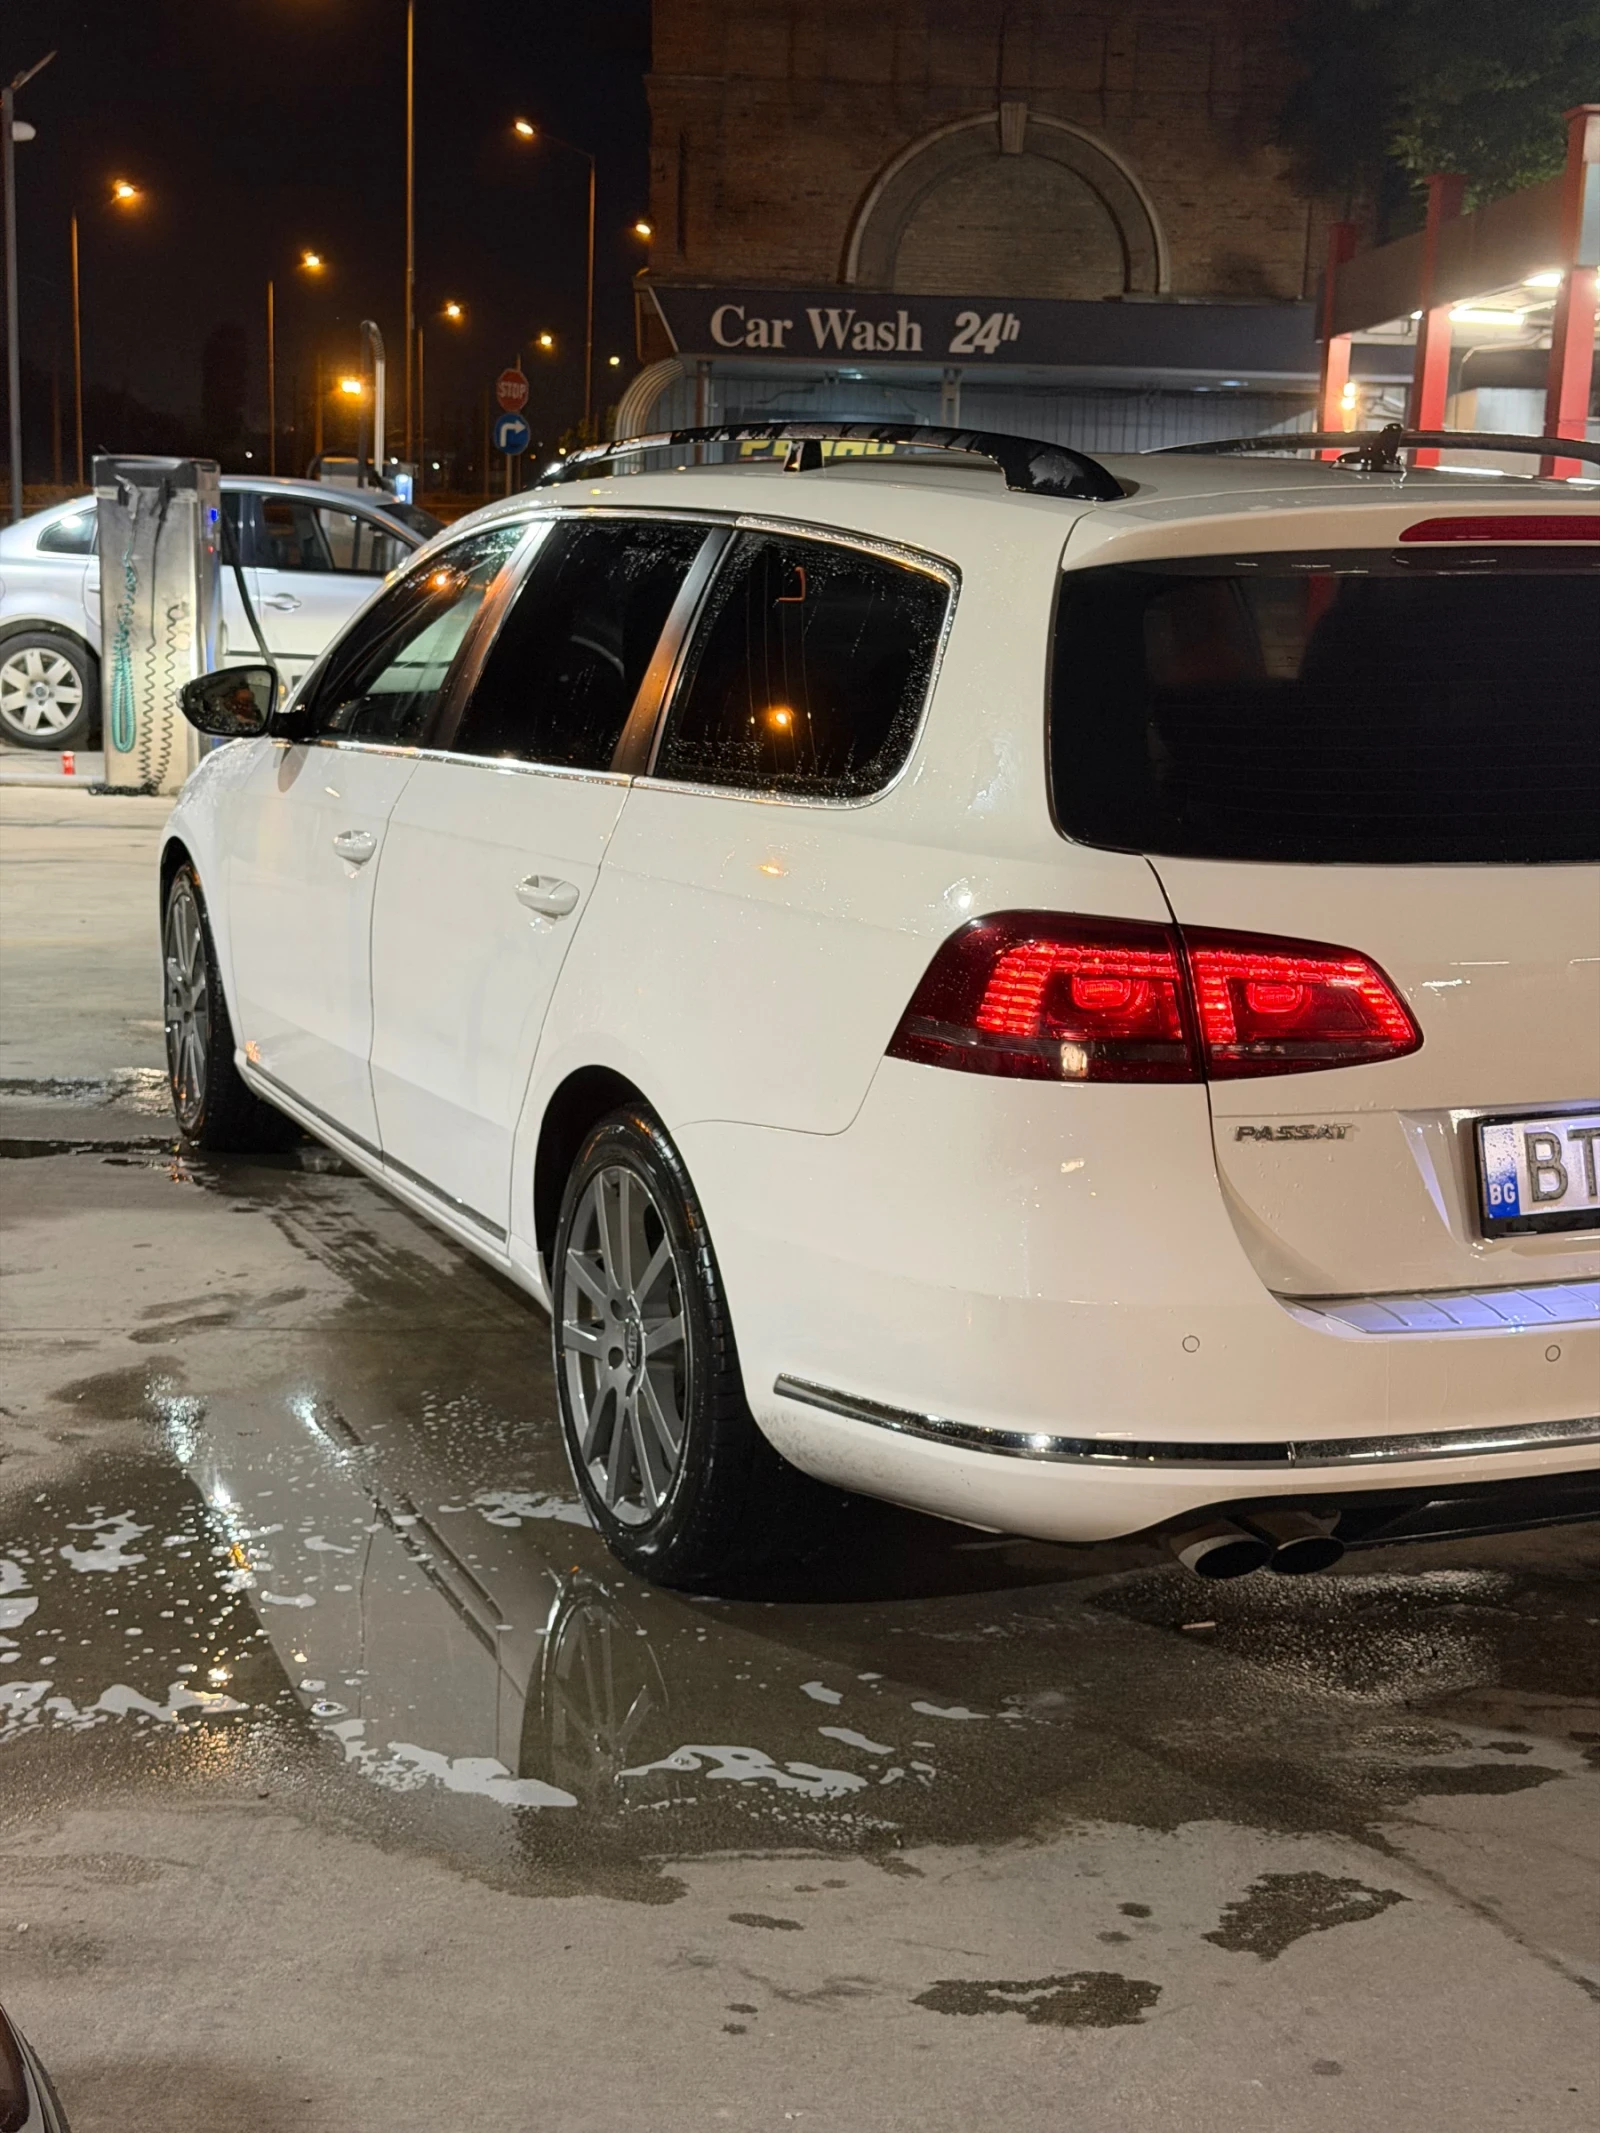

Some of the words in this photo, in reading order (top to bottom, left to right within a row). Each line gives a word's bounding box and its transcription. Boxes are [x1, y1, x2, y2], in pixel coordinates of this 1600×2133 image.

[710, 304, 793, 347] Car
[806, 308, 922, 351] Wash
[949, 311, 1021, 354] 24h
[498, 381, 527, 399] STOP
[1234, 1123, 1354, 1142] PASSAT
[1489, 1183, 1517, 1206] BG
